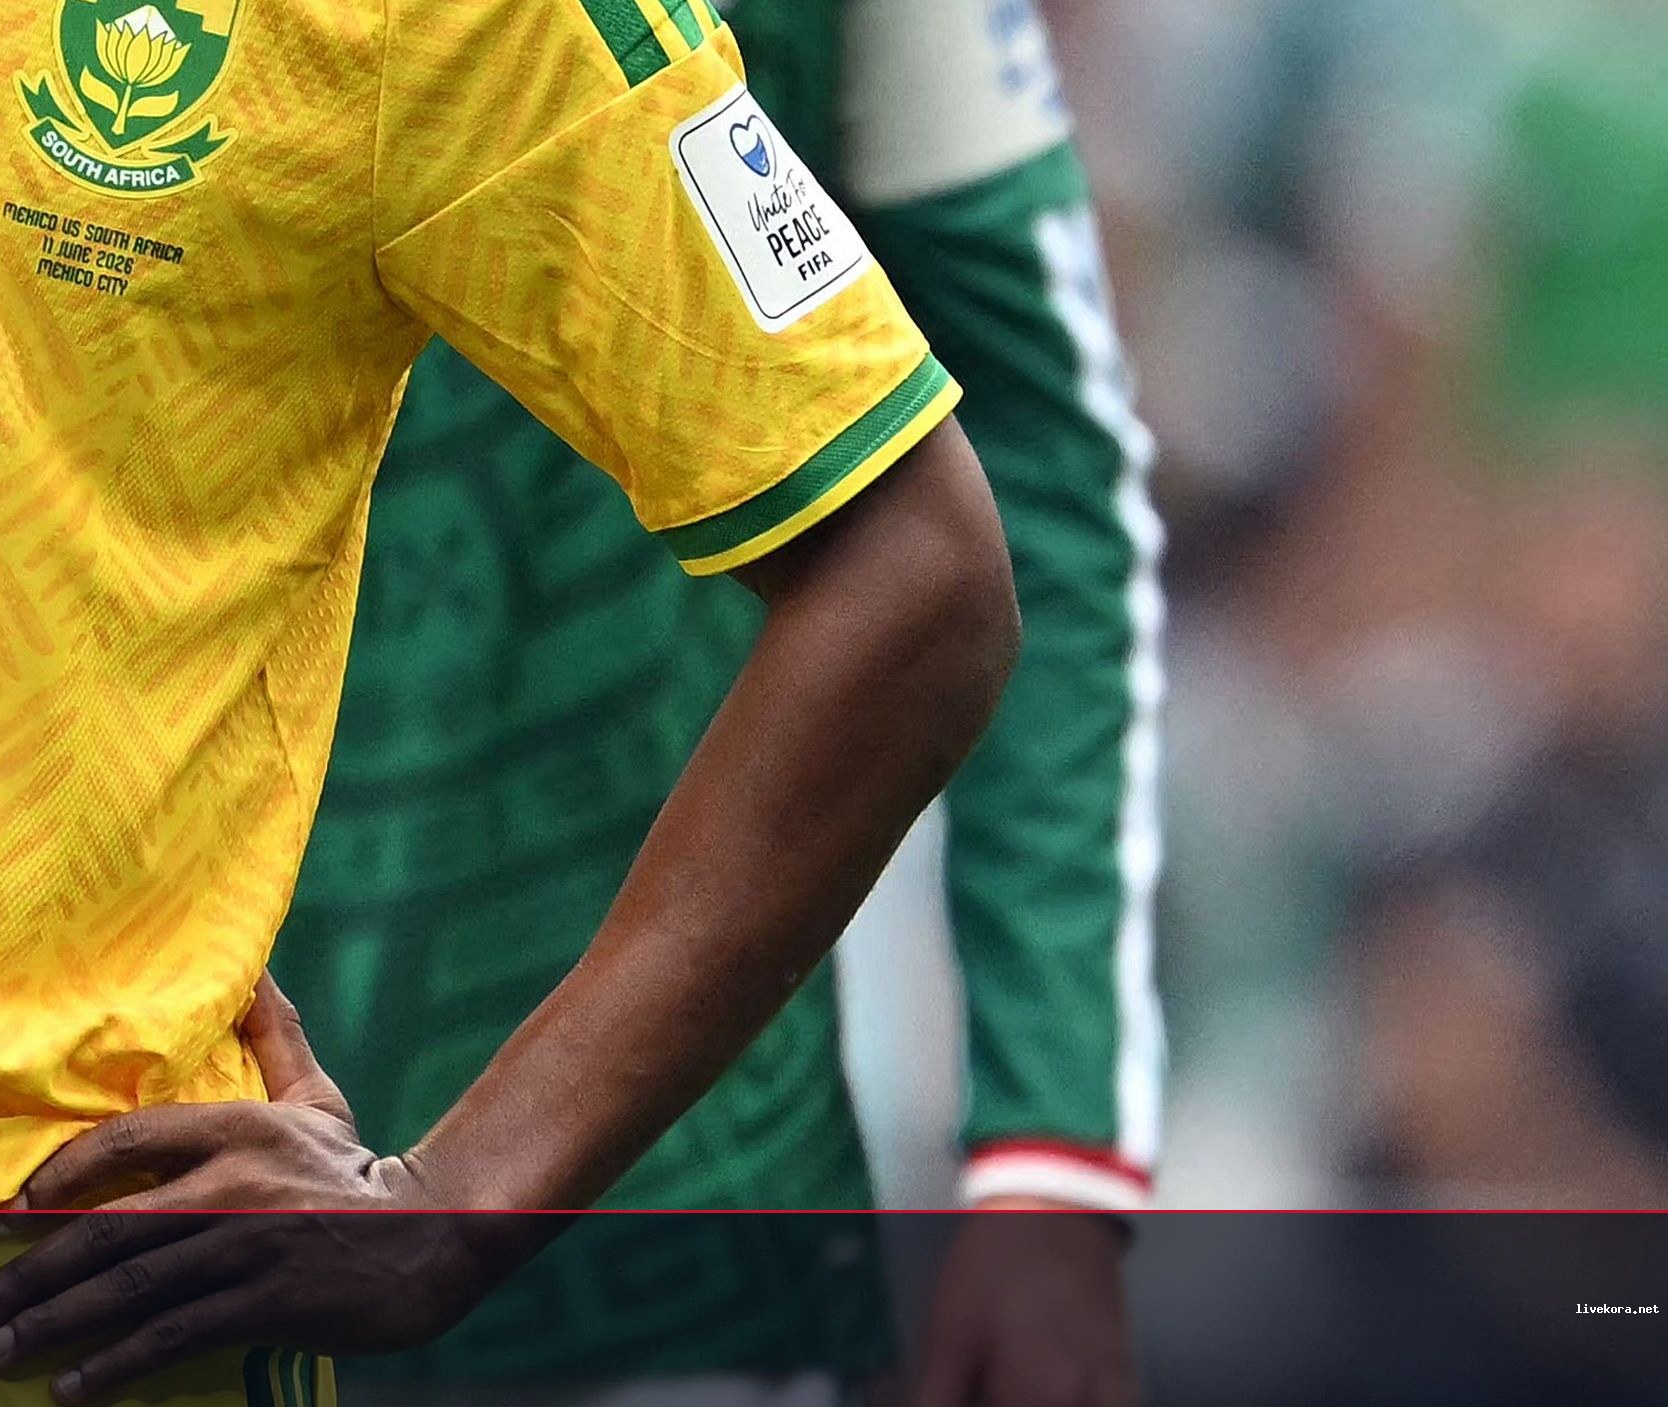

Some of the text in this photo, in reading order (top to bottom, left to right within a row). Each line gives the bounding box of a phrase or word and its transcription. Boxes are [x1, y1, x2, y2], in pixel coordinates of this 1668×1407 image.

[41, 130, 181, 187] SOUTH AFRICA
[84, 224, 131, 250] SOUTH
[132, 236, 185, 264] AFRICA
[766, 203, 830, 267] PEACE
[55, 240, 93, 264] JUNE
[95, 250, 135, 275] 2026
[797, 251, 833, 281] FIFA
[96, 274, 129, 297] CITY
